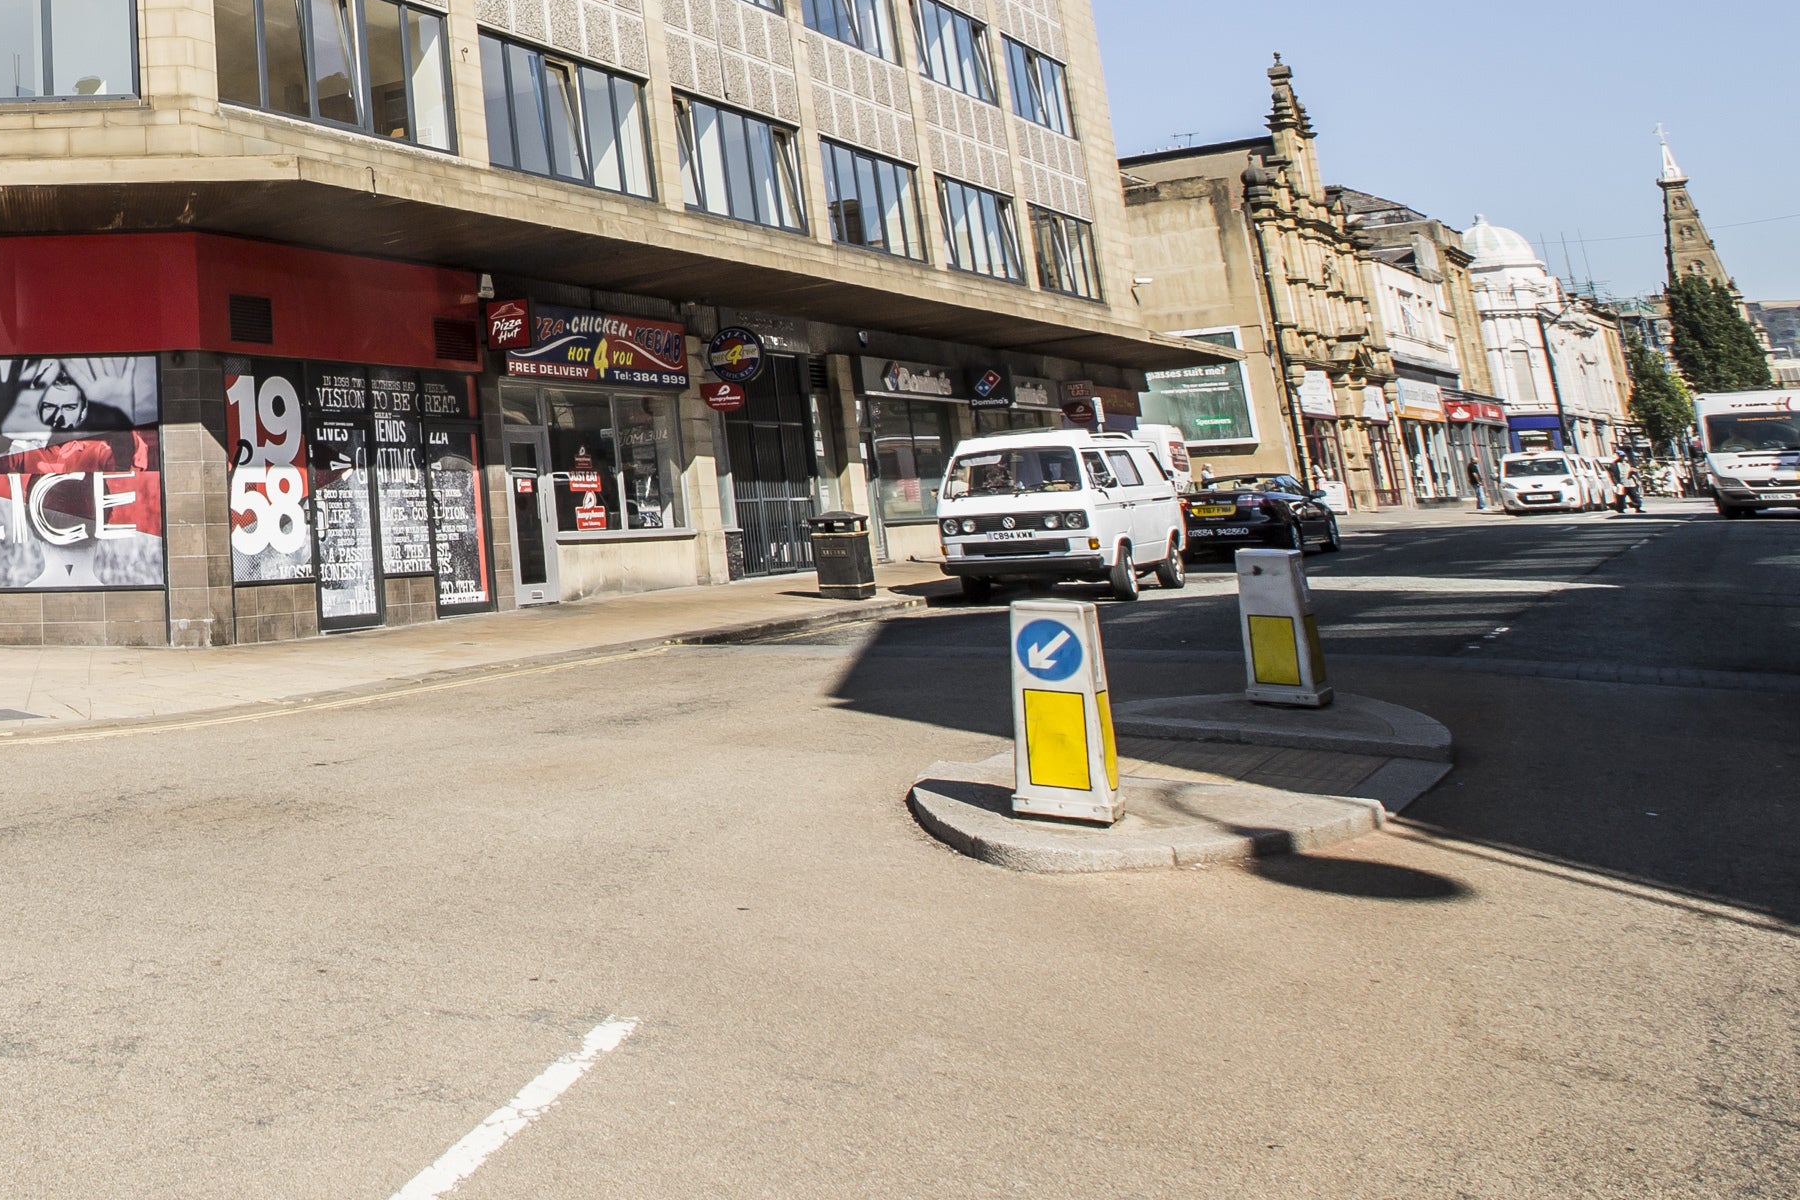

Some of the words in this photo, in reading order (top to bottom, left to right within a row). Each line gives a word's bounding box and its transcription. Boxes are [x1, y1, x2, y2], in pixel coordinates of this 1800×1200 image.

[492, 318, 523, 336] Pizza
[498, 328, 520, 344] Hut
[571, 316, 628, 338] CHICKEN
[634, 326, 683, 364] KEBAB
[567, 346, 591, 362] HOT
[594, 337, 609, 379] 4
[612, 351, 633, 367] YOU
[725, 344, 743, 365] 4
[508, 361, 537, 374] FREE
[539, 364, 590, 377] DELIVERY
[1183, 367, 1204, 377] suit
[371, 379, 401, 391] ROTHERS
[662, 374, 686, 385] 999
[316, 387, 366, 409] VISION
[371, 390, 388, 410] TO
[392, 392, 411, 412] BE
[971, 396, 1009, 407] Domino's
[226, 375, 303, 466] 19
[585, 471, 598, 482] EAT
[231, 463, 307, 556] 58
[403, 544, 425, 559] THE
[441, 581, 454, 595] TO
[455, 580, 476, 593] THE
